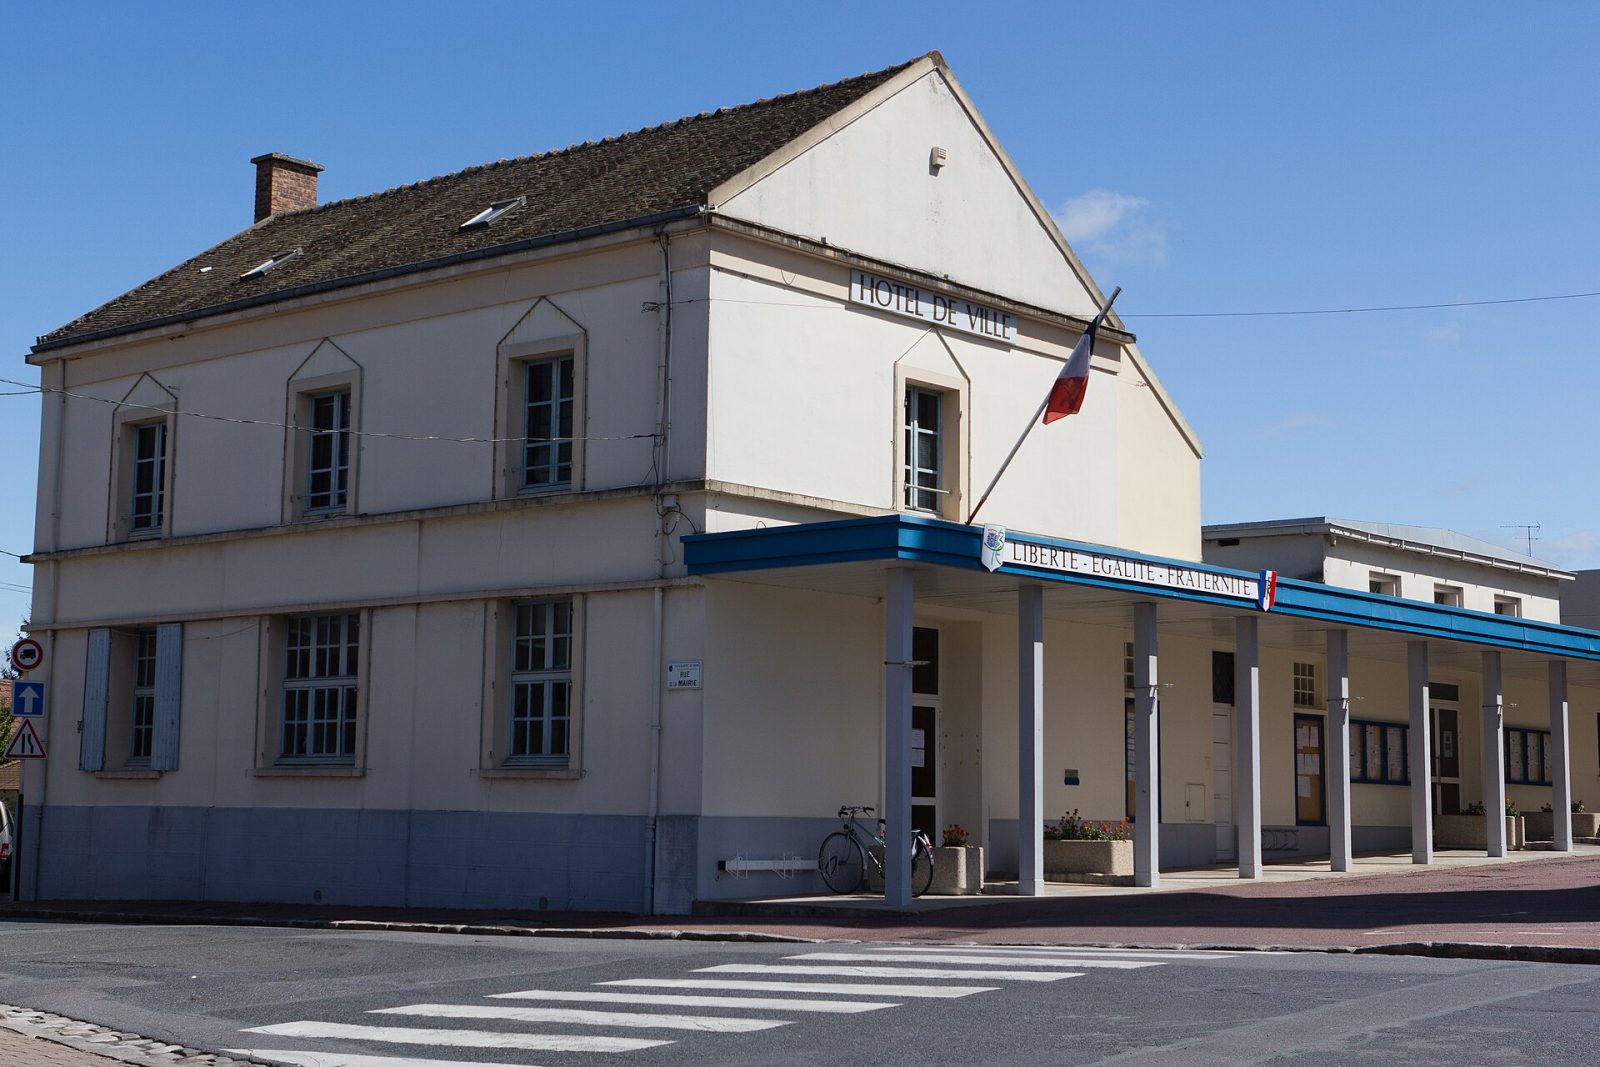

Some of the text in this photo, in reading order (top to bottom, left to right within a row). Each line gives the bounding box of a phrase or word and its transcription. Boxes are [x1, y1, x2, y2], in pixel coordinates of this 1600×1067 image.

[859, 274, 1011, 340] HOTEL DE VILLE
[1013, 541, 1079, 570] LIBERTE
[1092, 554, 1155, 581] EGALITE
[1167, 566, 1251, 596] FRATERNITE
[678, 679, 697, 687] MAIRIE
